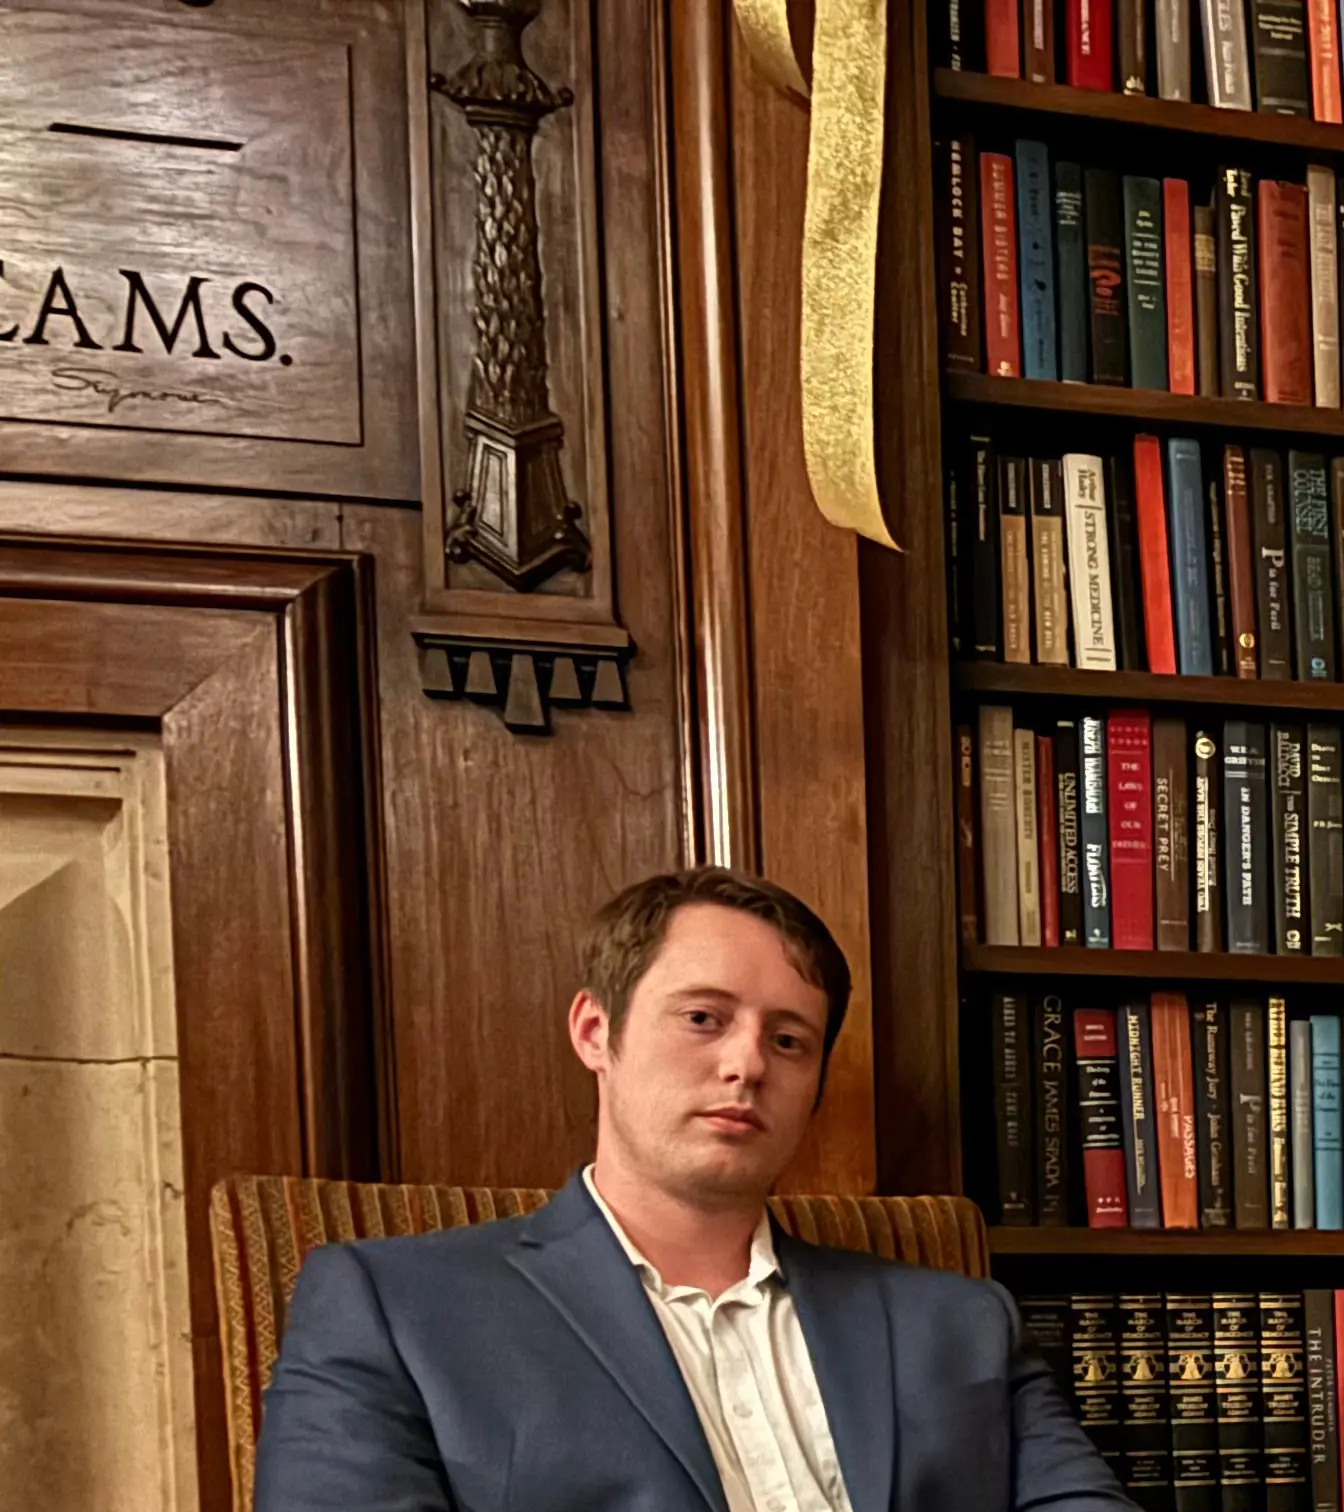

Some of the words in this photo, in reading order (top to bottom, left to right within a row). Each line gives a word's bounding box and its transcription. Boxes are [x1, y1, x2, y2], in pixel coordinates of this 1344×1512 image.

[950, 140, 963, 218] HEMLOCK
[952, 226, 963, 259] BAY
[1229, 204, 1248, 241] Paved
[1231, 243, 1249, 272] With
[1233, 274, 1250, 309] Good
[1083, 510, 1098, 569] STRONG
[1088, 573, 1104, 646] MEDICINE
[1289, 742, 1300, 778] DAVID
[1063, 772, 1076, 847] UNLIMITED
[1156, 778, 1168, 832] SECRET
[1157, 837, 1169, 871] PREY
[1283, 812, 1299, 864] SIMPLE
[1065, 849, 1078, 894] ACCESS
[1285, 866, 1300, 919] TRUTH
[1042, 995, 1061, 1073] GRACE
[1128, 1015, 1141, 1073] MIDNIGHT
[1044, 1080, 1059, 1133] JAMES
[1132, 1078, 1144, 1120] RUNNER
[1045, 1137, 1059, 1187] SPADA
[1183, 1115, 1194, 1179] PASSAGES
[1308, 1328, 1322, 1361] THE
[1310, 1368, 1326, 1464] INTRUDER
